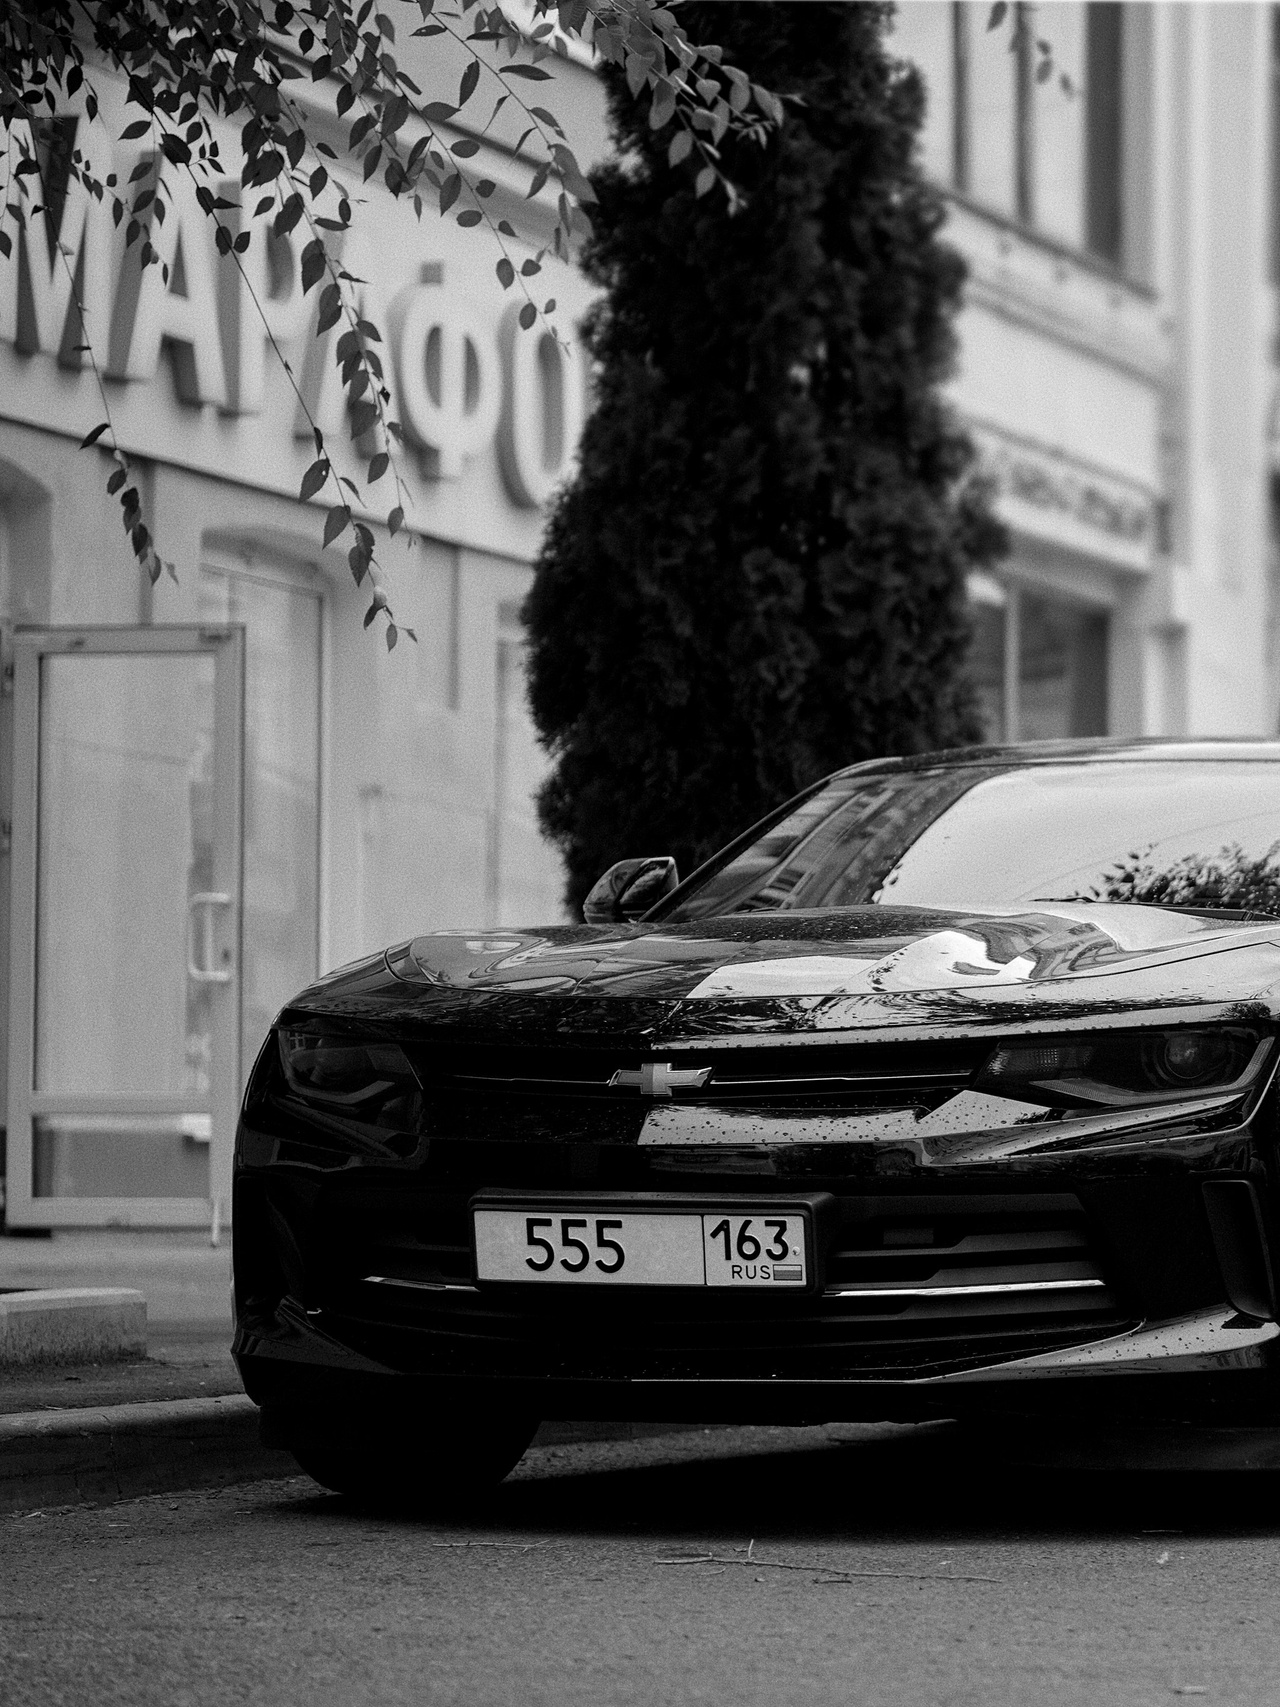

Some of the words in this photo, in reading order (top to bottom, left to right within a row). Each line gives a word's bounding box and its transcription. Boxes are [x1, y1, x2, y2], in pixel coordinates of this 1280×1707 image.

[525, 1217, 626, 1274] 555
[709, 1218, 790, 1262] 163
[731, 1264, 772, 1281] RUS
